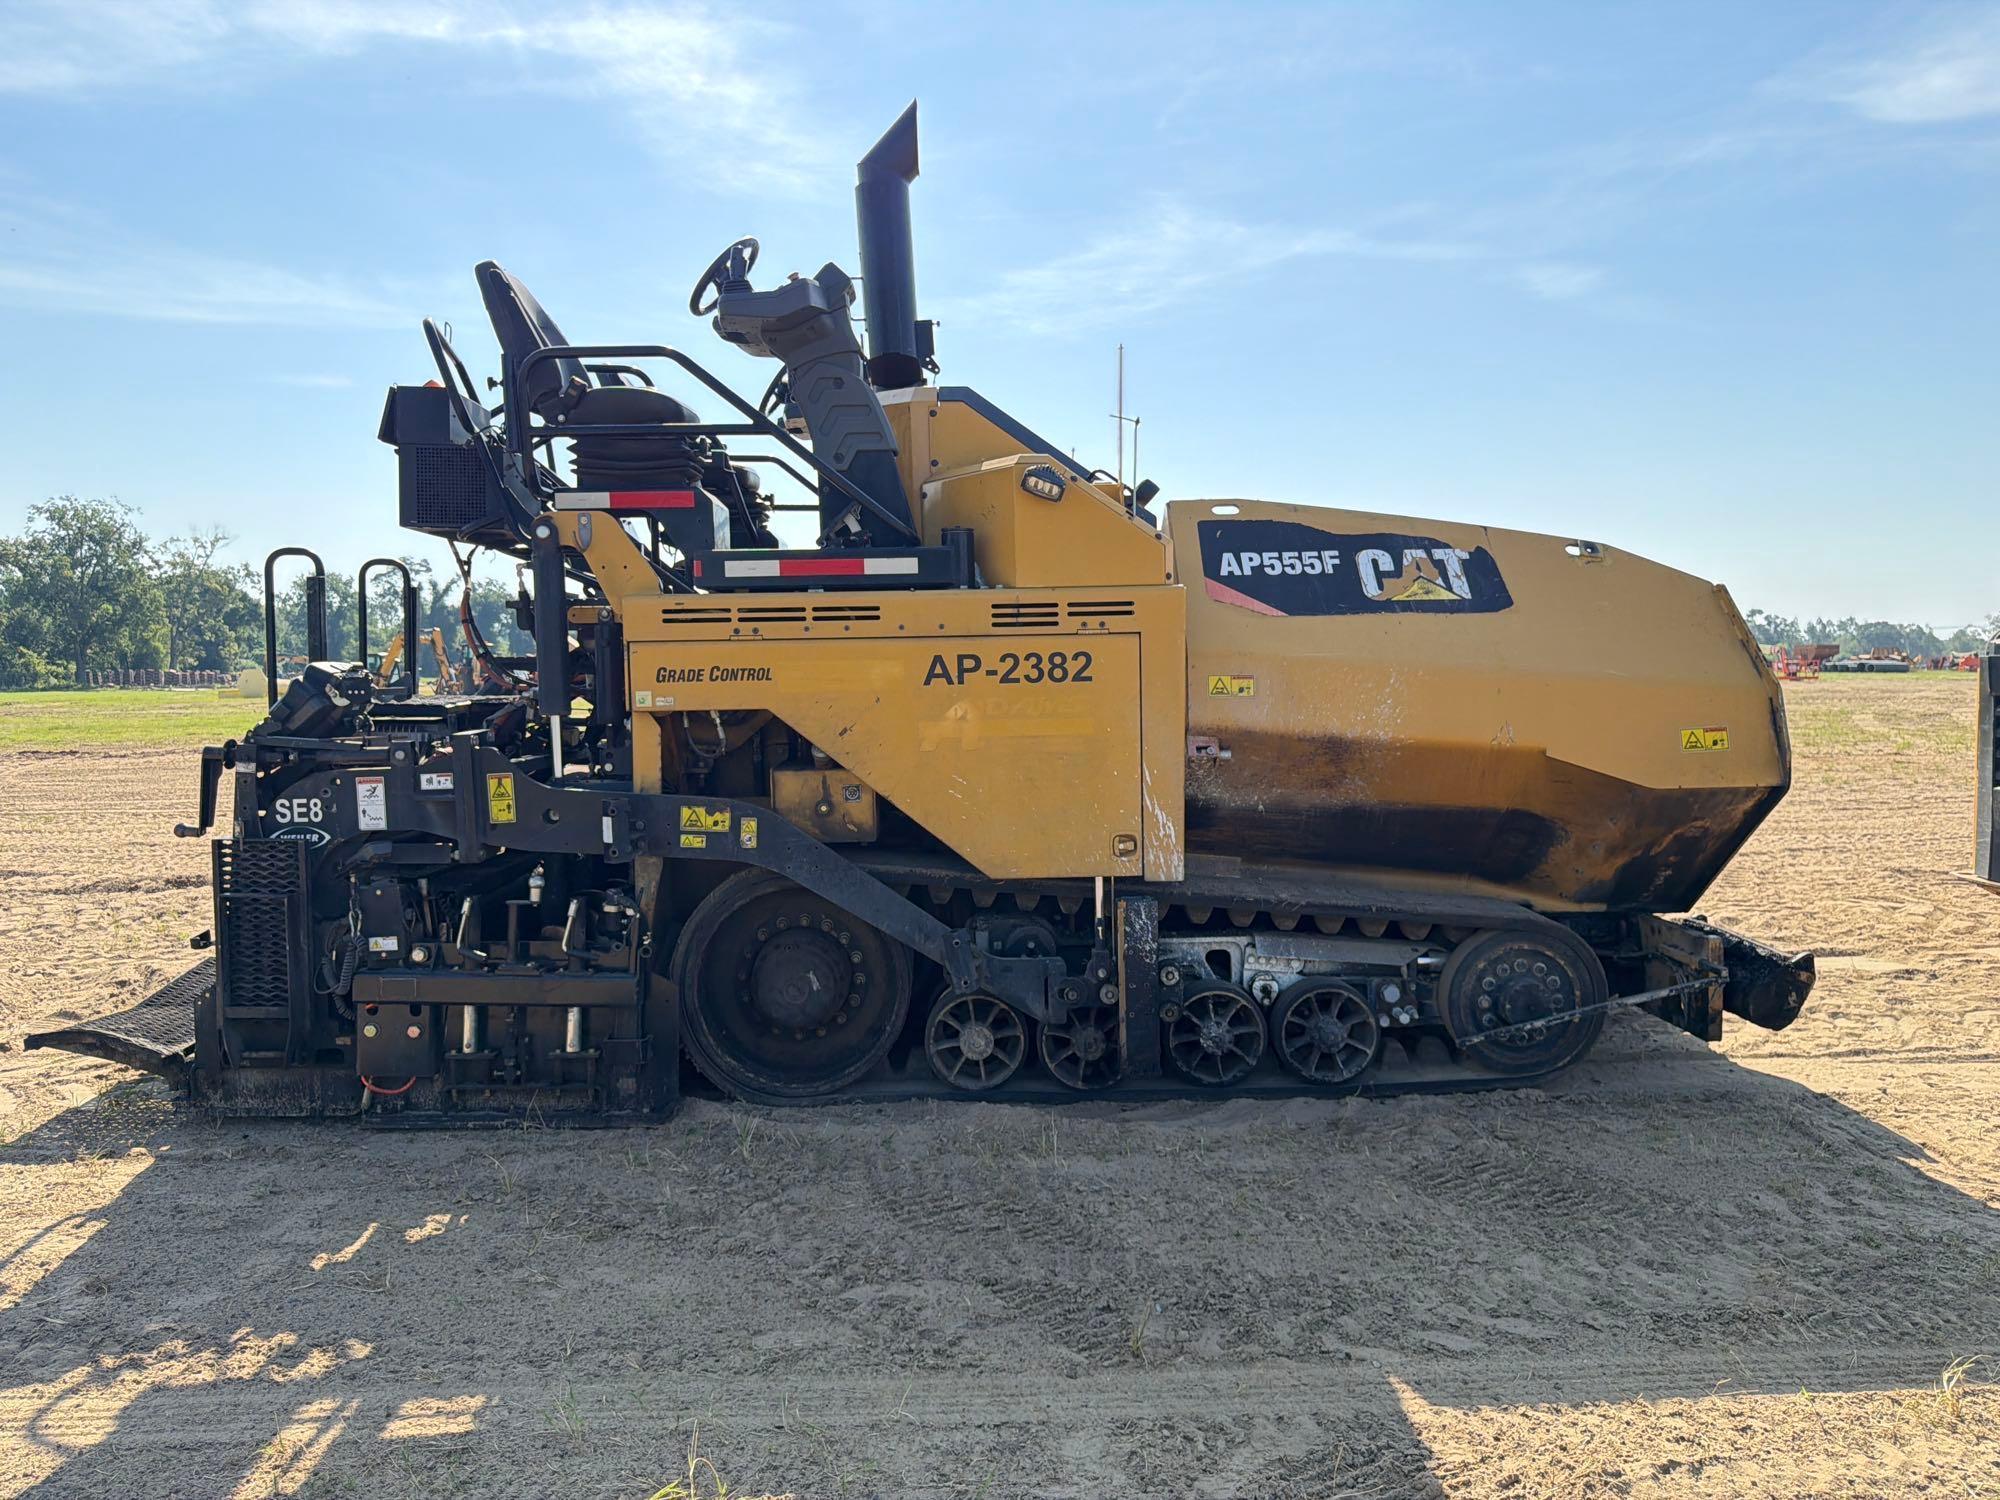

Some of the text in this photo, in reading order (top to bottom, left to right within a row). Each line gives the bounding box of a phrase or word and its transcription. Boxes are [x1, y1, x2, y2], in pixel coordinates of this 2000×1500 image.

[1219, 549, 1341, 577] AP555F
[655, 665, 773, 684] GRADE CONTROL
[922, 651, 1094, 686] AP-2382
[275, 798, 323, 824] SE8
